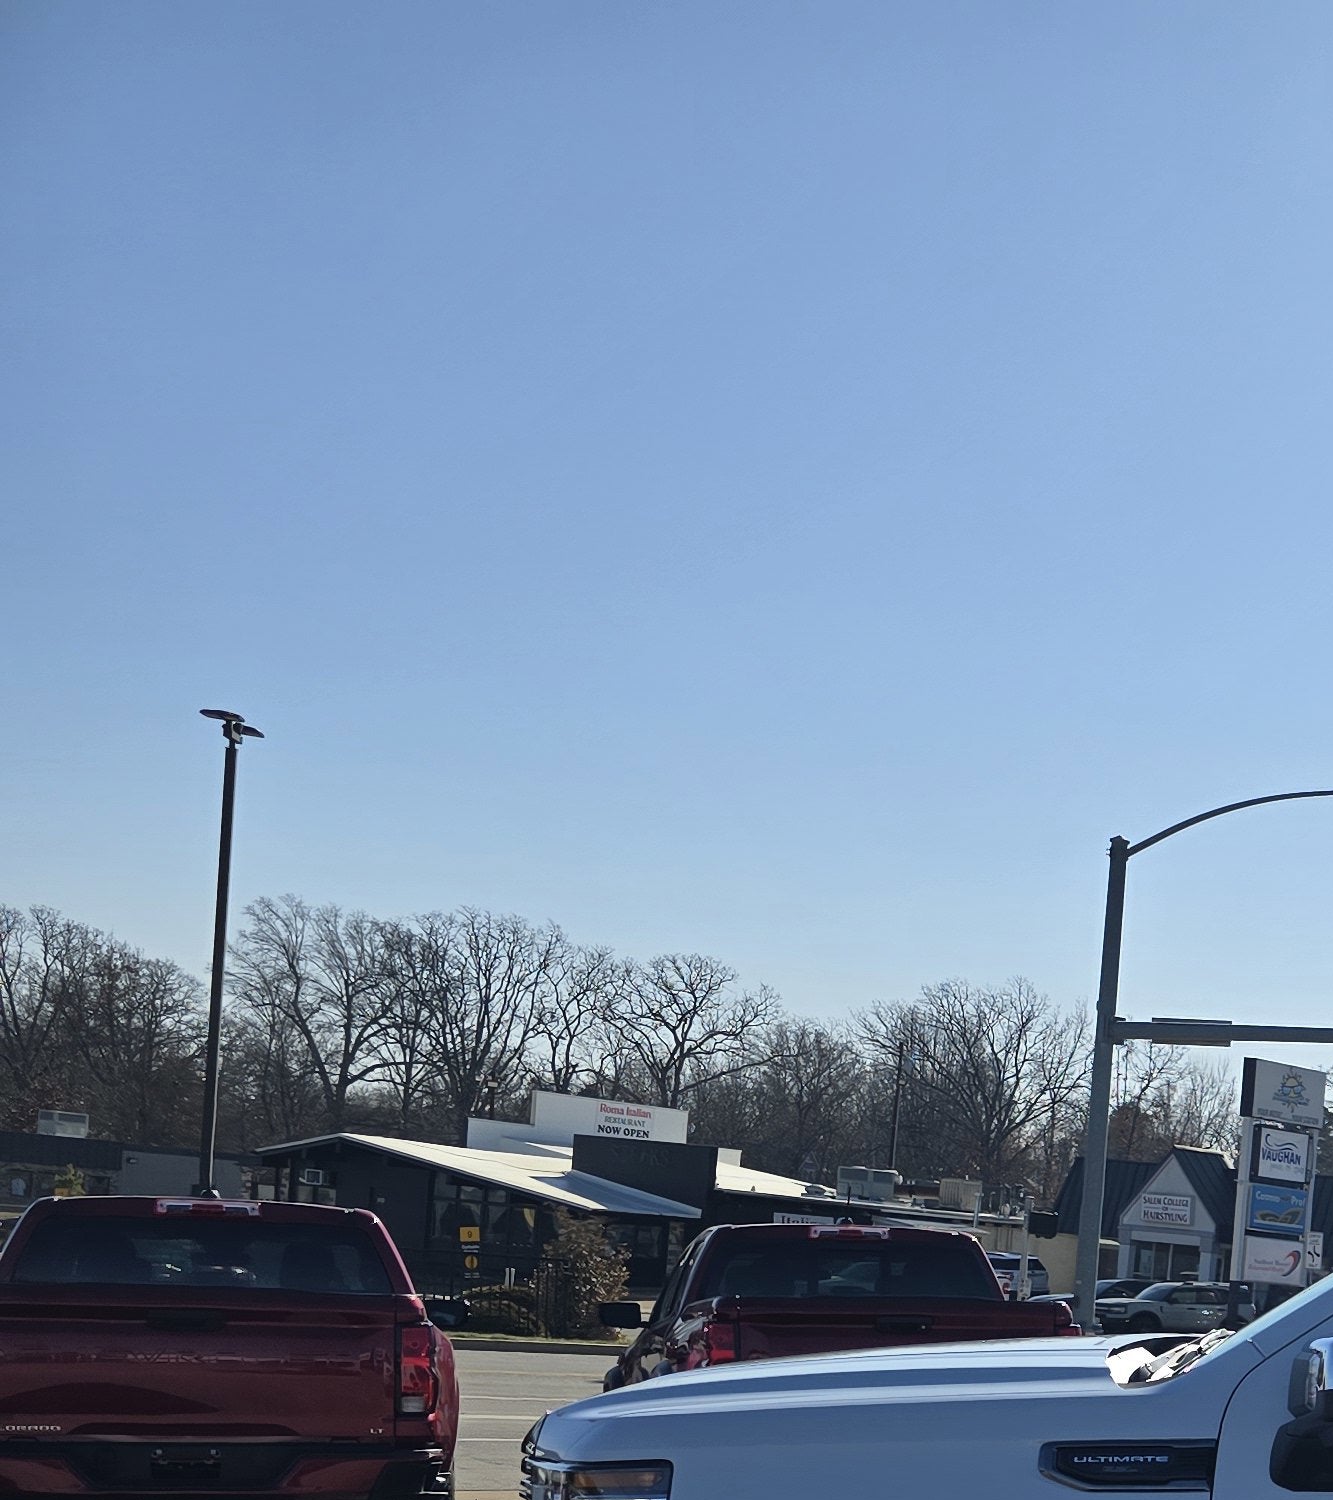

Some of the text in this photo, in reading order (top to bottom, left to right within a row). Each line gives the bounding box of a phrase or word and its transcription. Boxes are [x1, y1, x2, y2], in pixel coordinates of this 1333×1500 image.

[600, 1103, 624, 1115] Roma
[597, 1124, 650, 1139] NOW OPEN
[1262, 1147, 1301, 1165] VAUGHAN
[1163, 1197, 1189, 1207] COLLEGE
[1073, 1455, 1169, 1463] ULTIMATE
